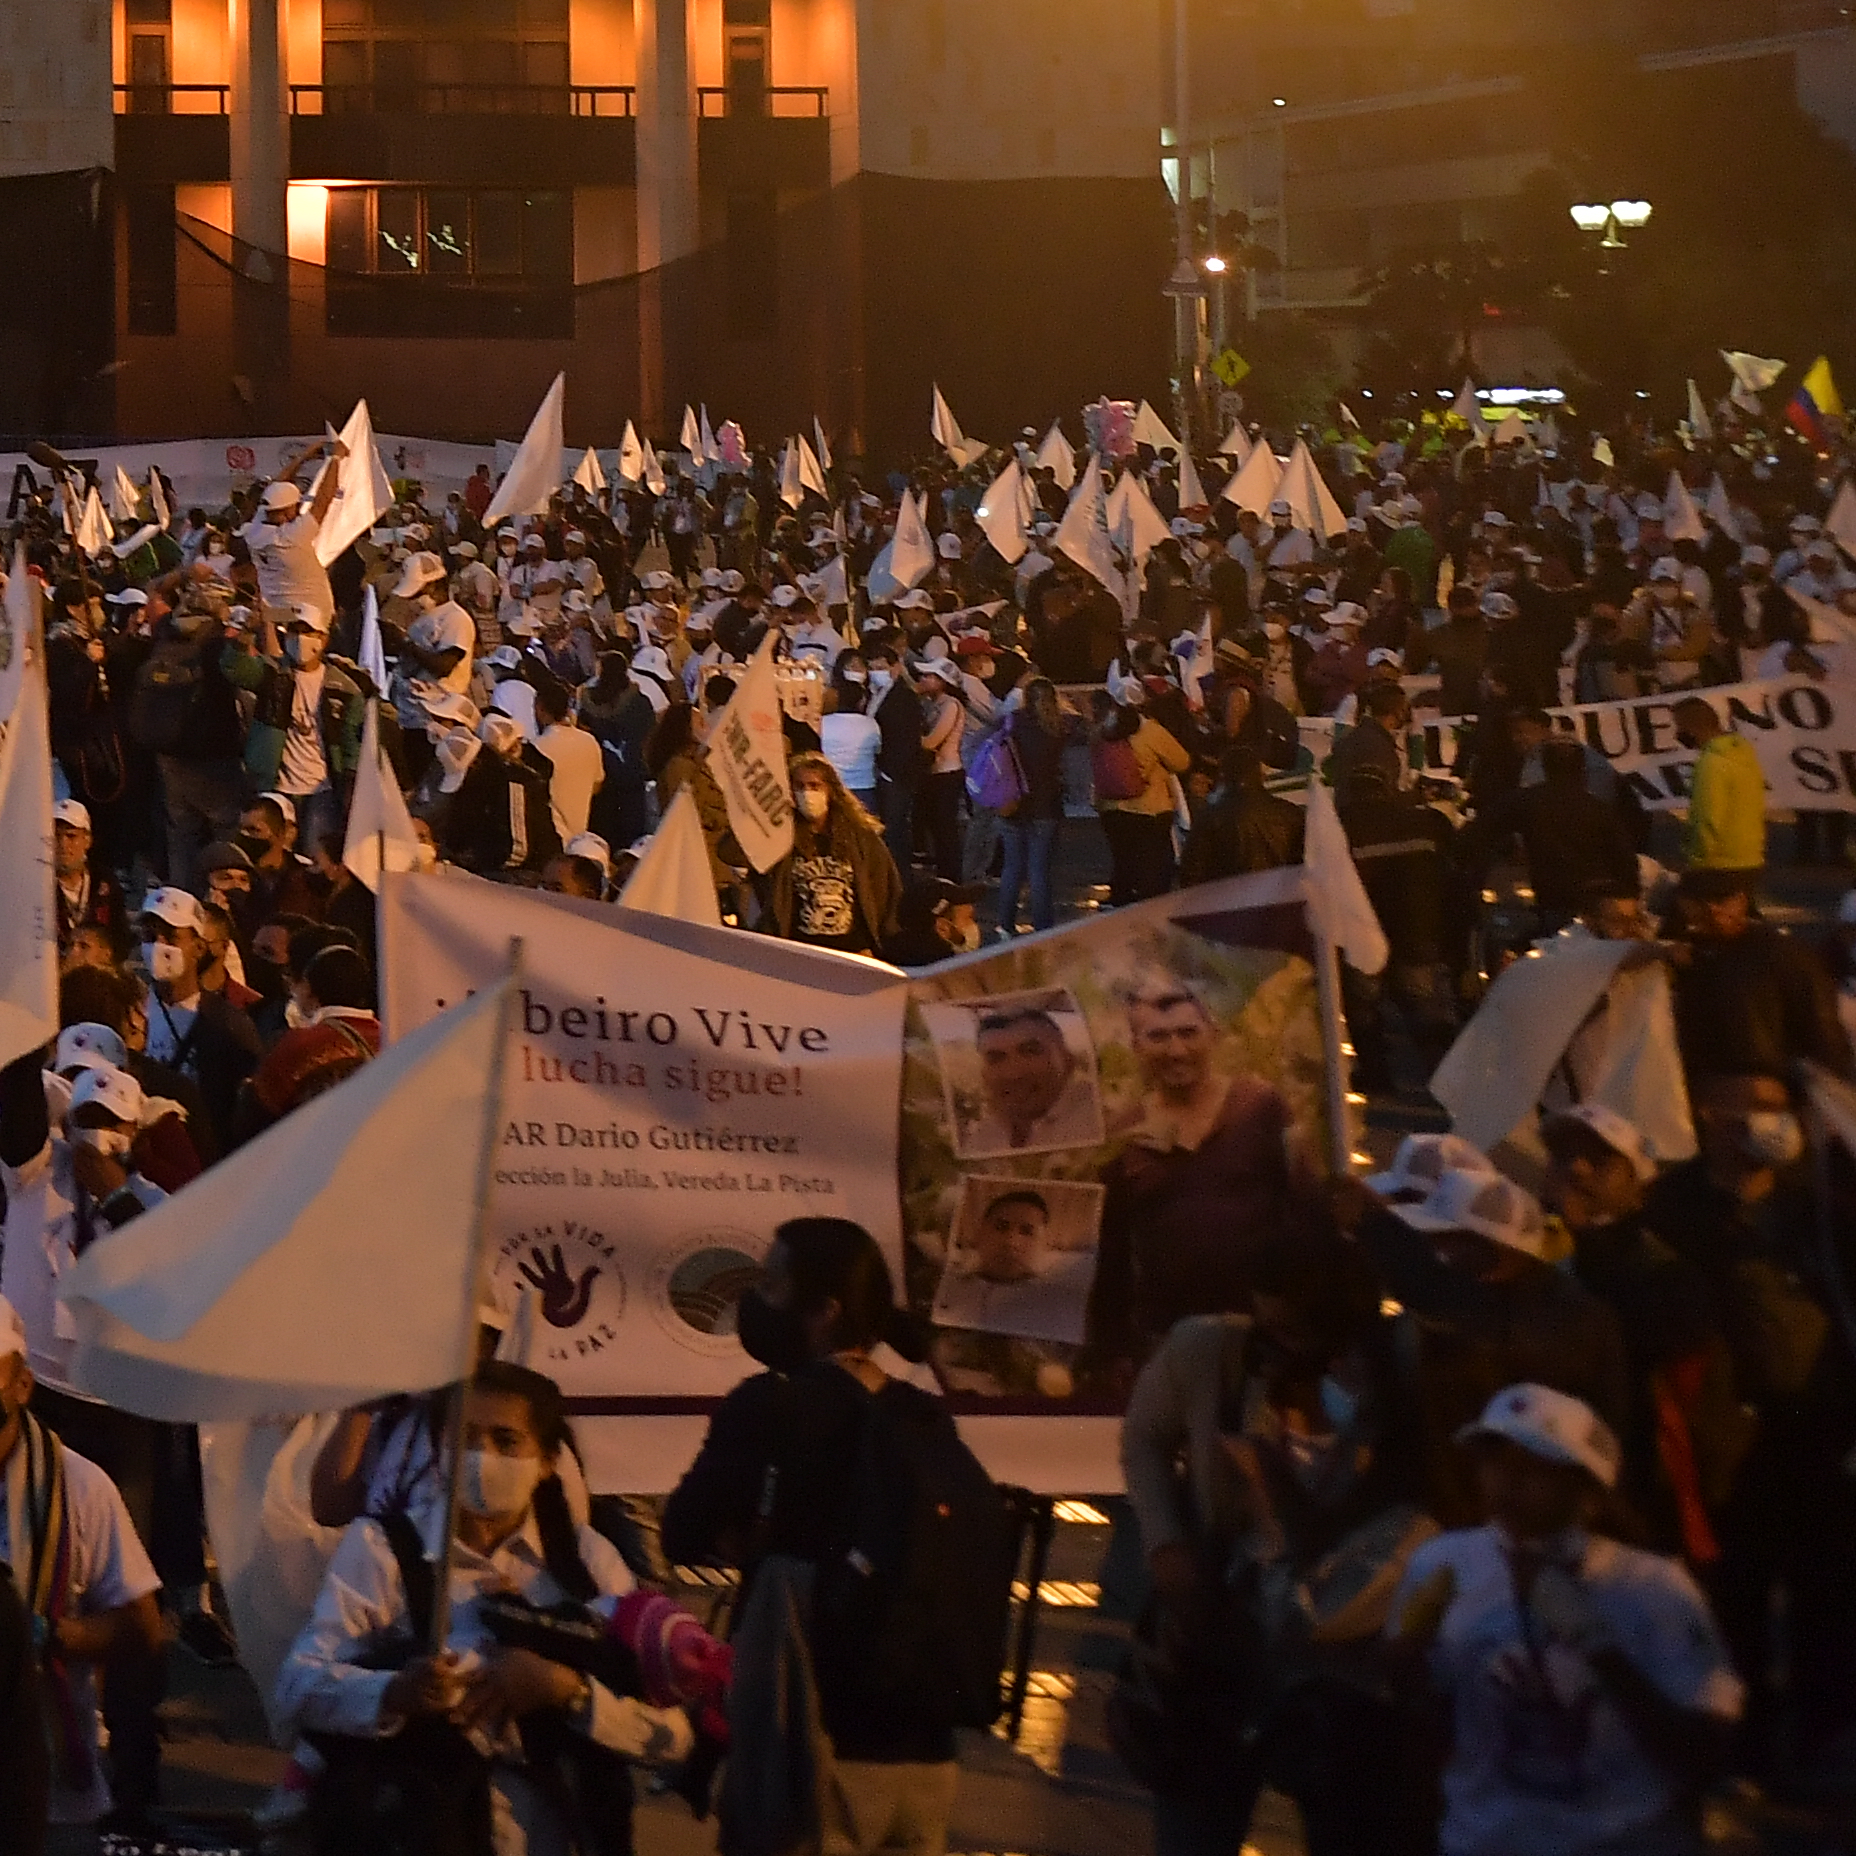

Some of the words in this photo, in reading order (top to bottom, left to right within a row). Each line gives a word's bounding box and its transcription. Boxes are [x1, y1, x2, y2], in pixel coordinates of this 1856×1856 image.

[691, 1008, 830, 1053] Vive
[522, 1045, 646, 1087] lucha
[664, 1058, 803, 1102] sigue!
[503, 1121, 548, 1146] AR
[494, 1167, 566, 1187] ección
